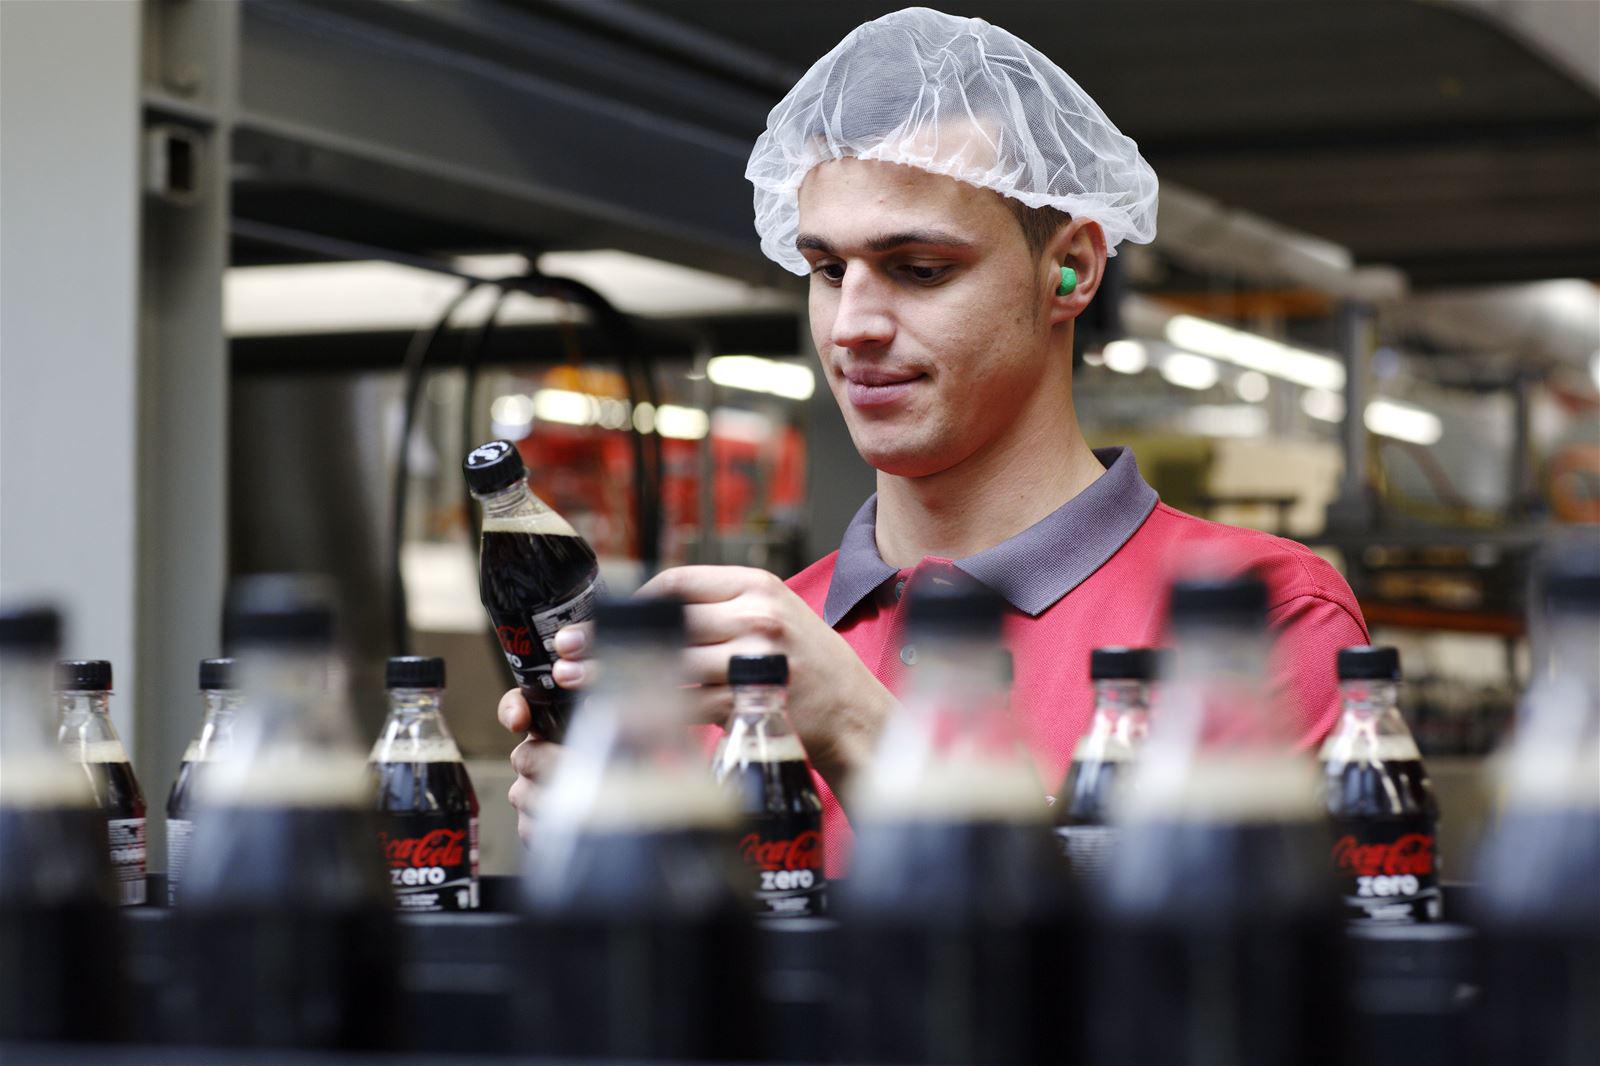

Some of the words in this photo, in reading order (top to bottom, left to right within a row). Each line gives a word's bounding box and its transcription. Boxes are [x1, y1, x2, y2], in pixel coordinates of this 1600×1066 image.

[389, 867, 446, 886] zero
[761, 869, 814, 890] zero
[1356, 874, 1419, 897] zero
